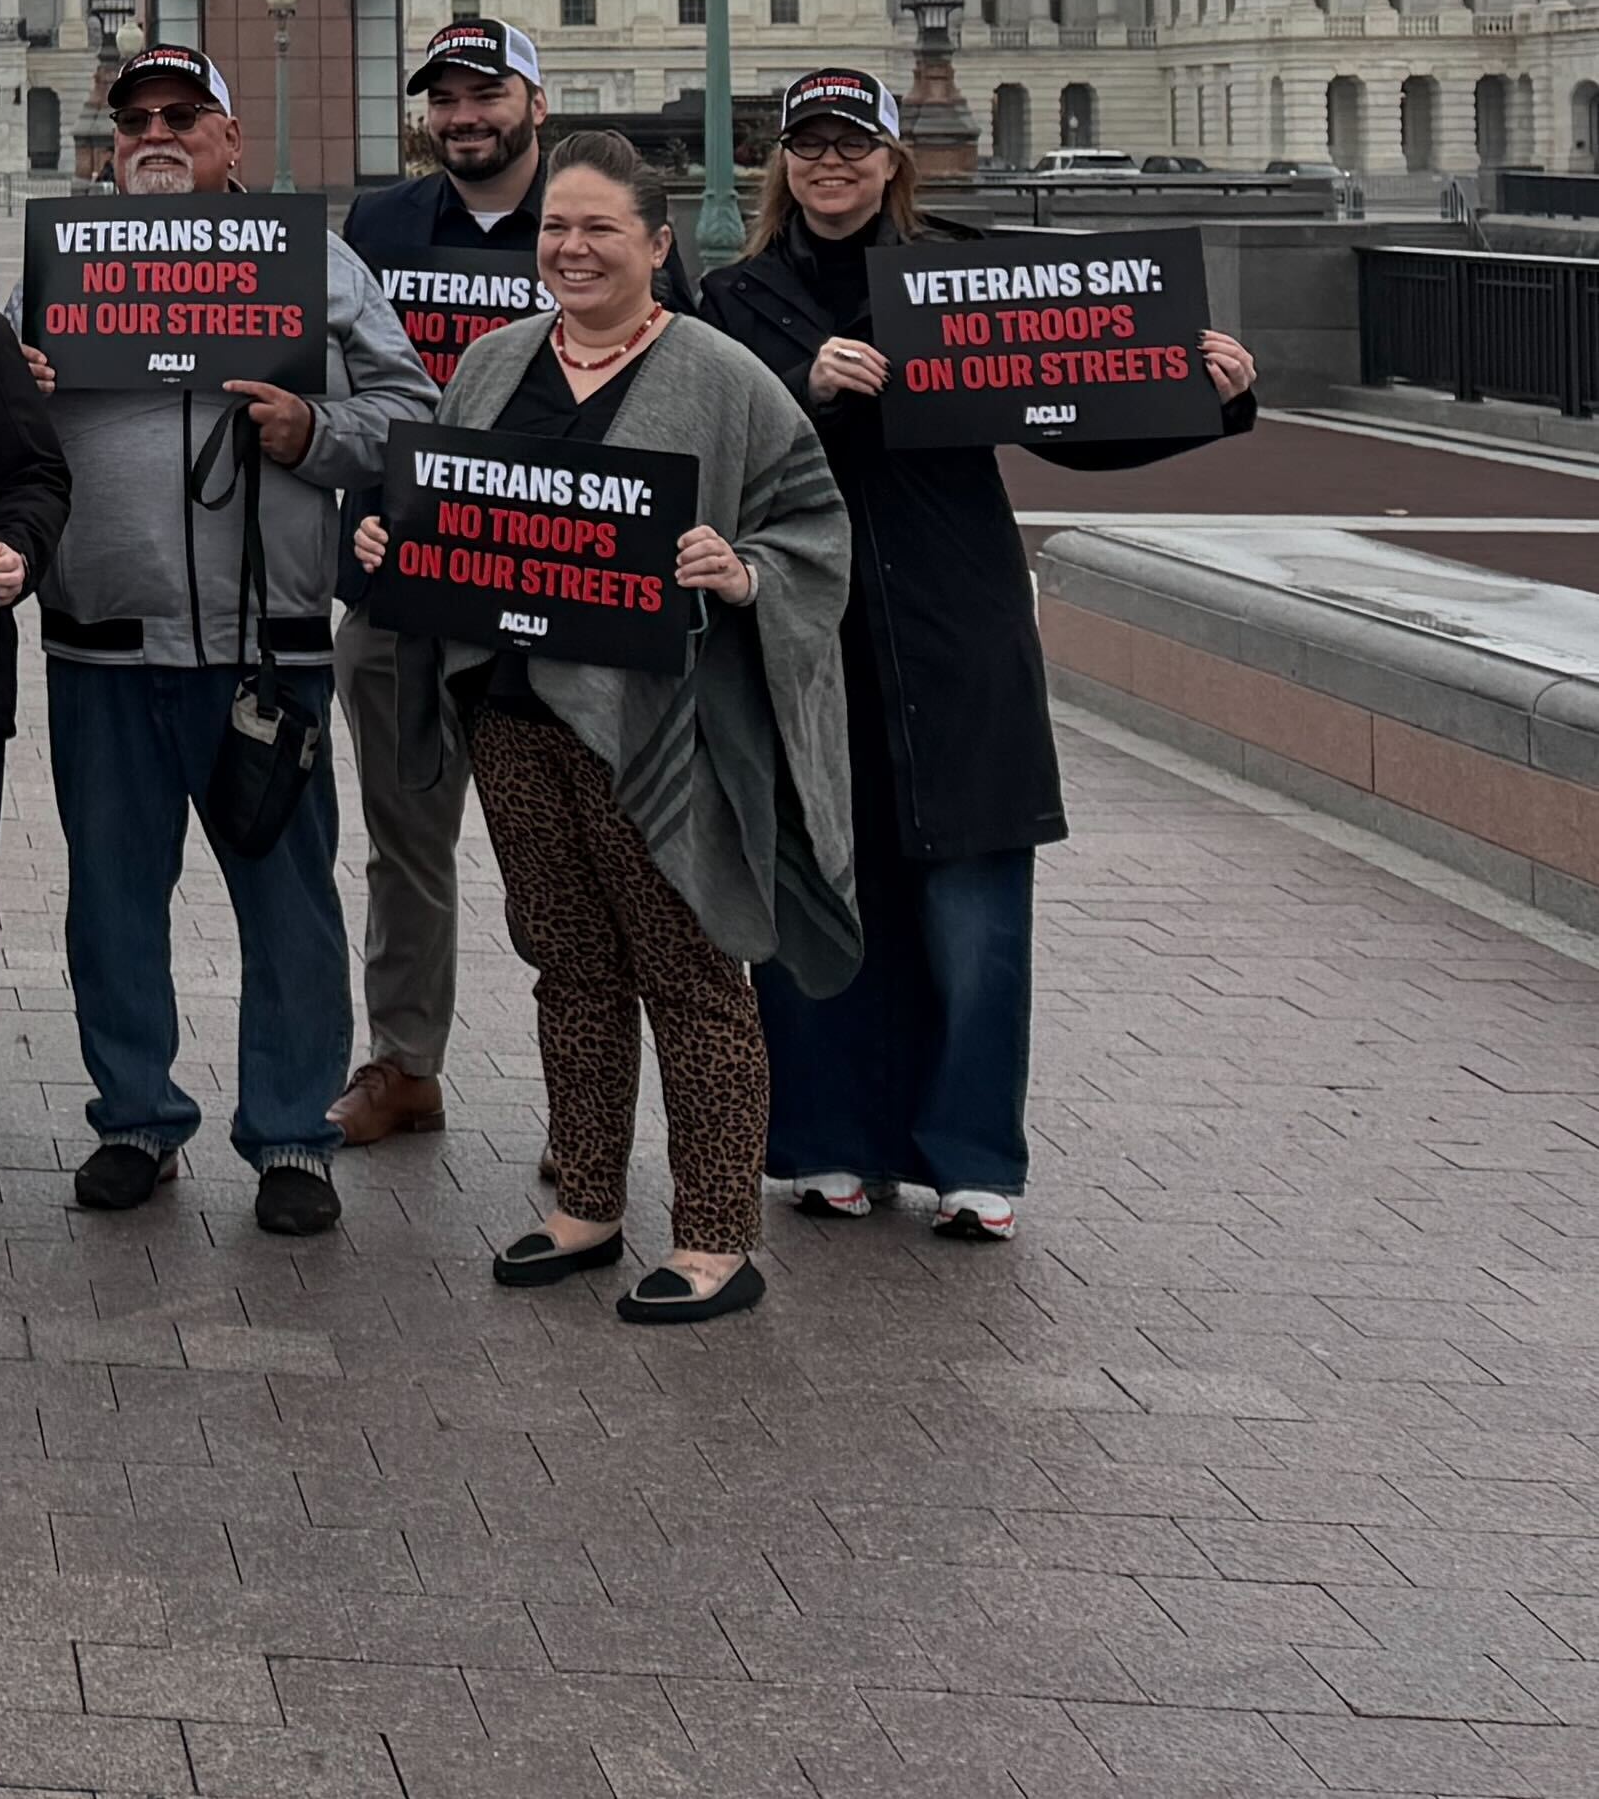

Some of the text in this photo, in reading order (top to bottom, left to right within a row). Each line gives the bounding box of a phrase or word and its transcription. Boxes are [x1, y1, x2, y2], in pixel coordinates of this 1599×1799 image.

[55, 219, 286, 253] VETERANS SAY:
[83, 262, 257, 294] NO TROOPS
[381, 269, 530, 309] VETERANS
[903, 259, 1162, 305] VETERANS SAY:
[46, 303, 303, 338] ON OUR STREETS
[405, 311, 445, 342] NO
[942, 305, 1134, 346] NO TROOPS
[148, 354, 195, 372] ACLU
[905, 346, 1189, 392] ON OUR STREETS
[1026, 405, 1076, 424] ACLU
[415, 452, 652, 516] VETERANS SAY:
[438, 501, 617, 558] NO TROOPS
[399, 541, 663, 612] ON OUR STREETS
[499, 611, 548, 636] ACLU
